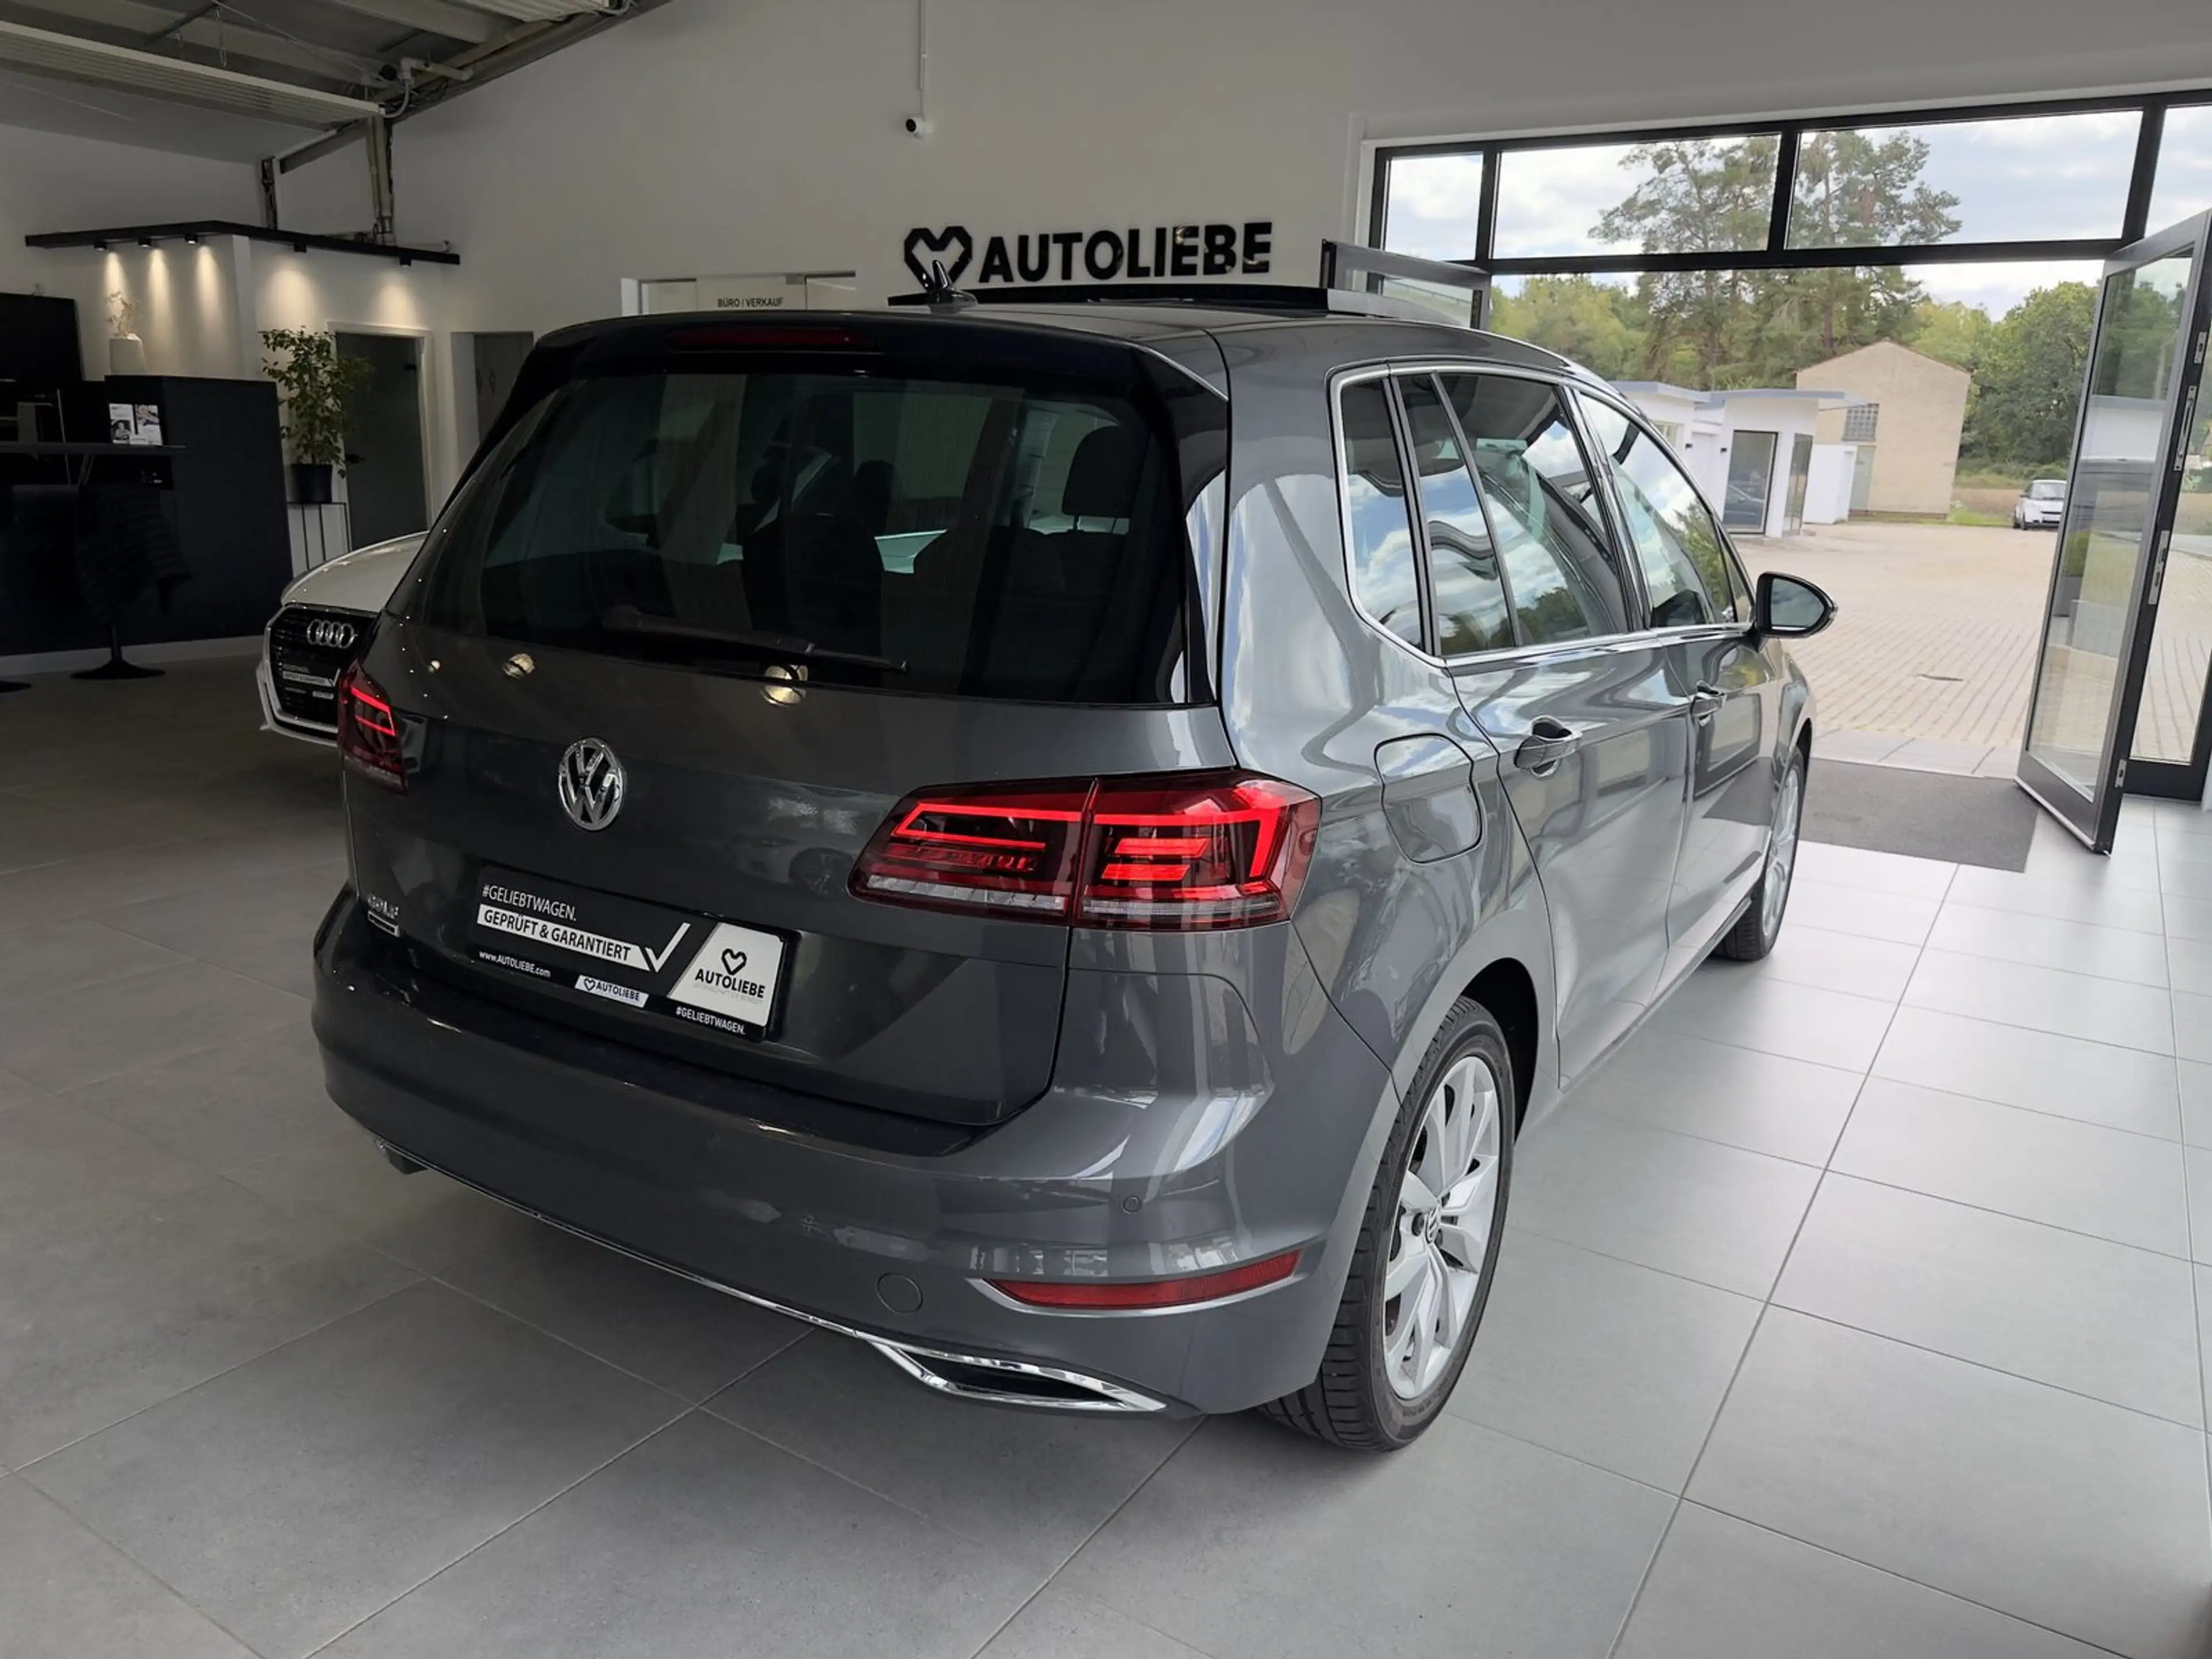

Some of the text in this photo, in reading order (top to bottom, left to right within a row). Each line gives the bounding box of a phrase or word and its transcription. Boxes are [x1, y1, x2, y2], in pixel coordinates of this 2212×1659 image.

[979, 222, 1272, 283] AUTOLIEBE
[717, 297, 740, 308] BÜRO
[745, 297, 784, 307] VERKAUF
[482, 885, 576, 921] #GELIEBTWAGEN.
[484, 909, 631, 961] GEPRÜFT & GARANTIERT
[479, 951, 551, 978] www.AUTOLIEBE.com
[596, 982, 640, 1002] AUTOLIEBE
[695, 968, 766, 999] AUTOLIEBE
[676, 1006, 746, 1035] #GELIEBTWAGEN.
